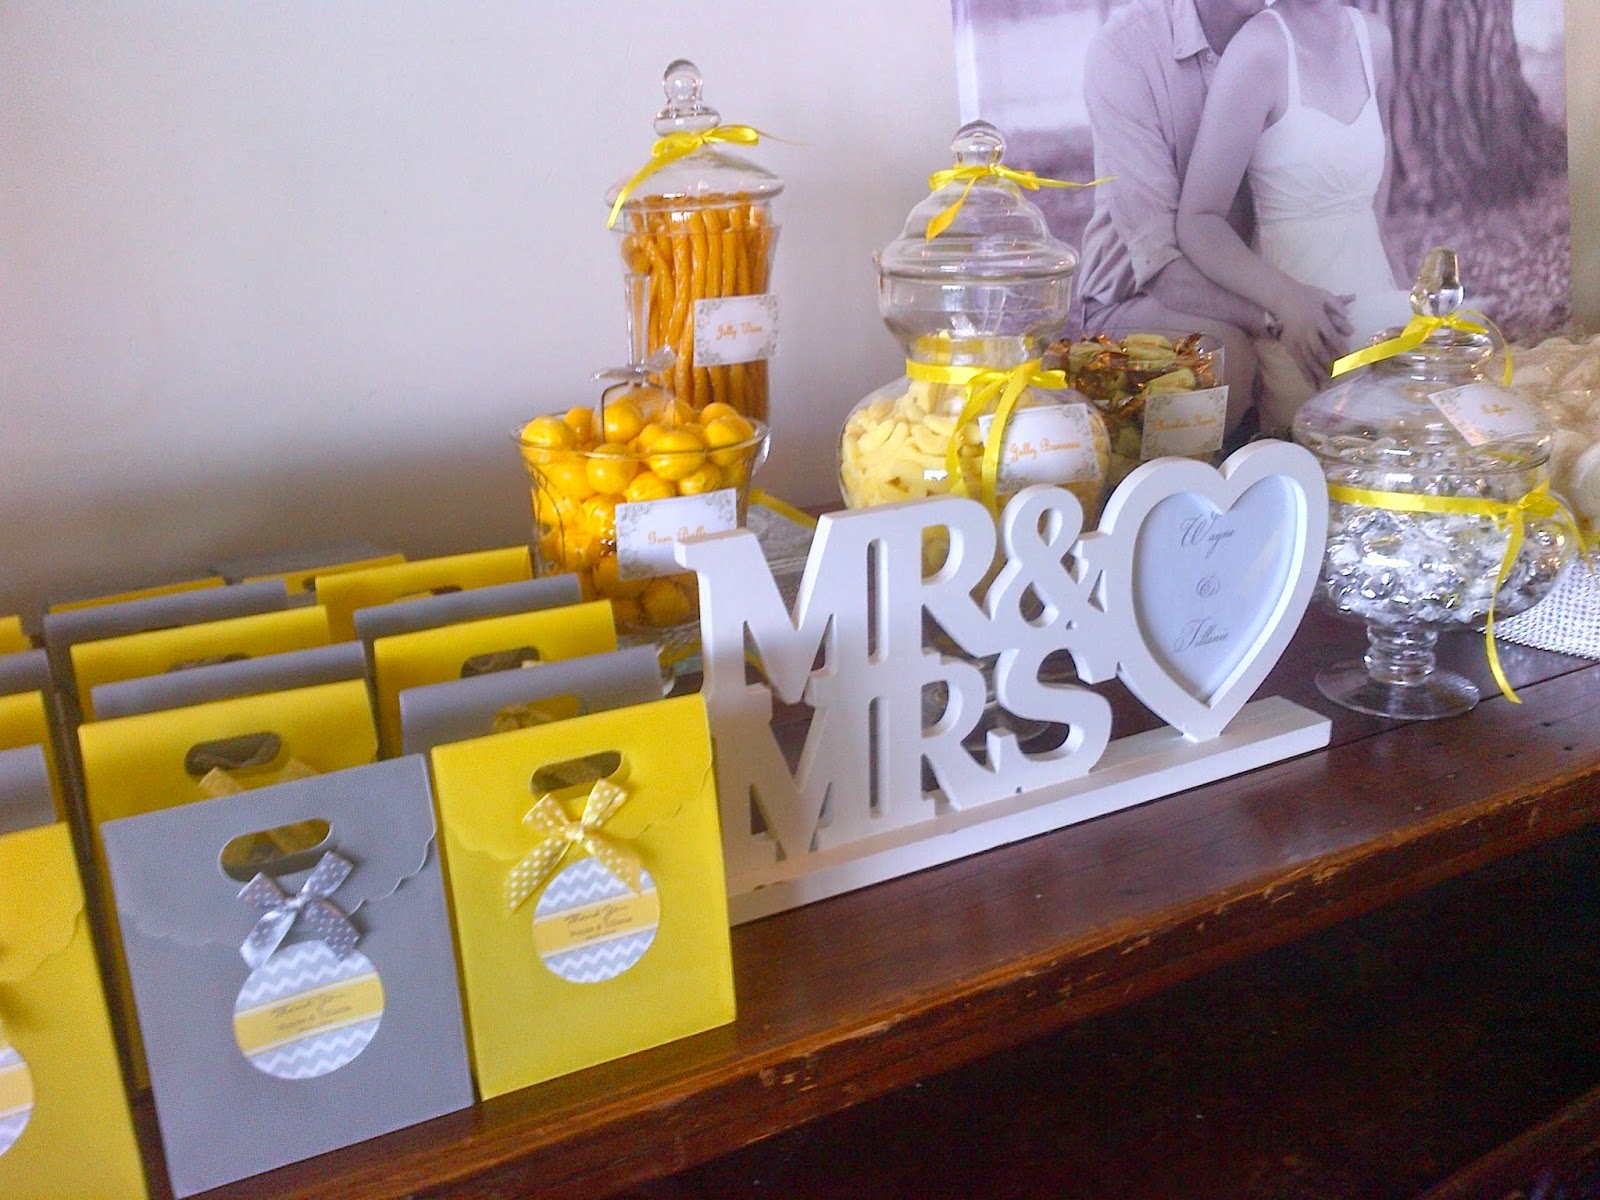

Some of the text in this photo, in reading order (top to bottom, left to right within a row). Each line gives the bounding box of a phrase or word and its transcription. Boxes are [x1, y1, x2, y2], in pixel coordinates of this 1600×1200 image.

[1009, 442, 1037, 463] Jelly
[674, 493, 996, 706] MR
[1180, 511, 1235, 560] Wayne
[704, 647, 1113, 868] MRS
